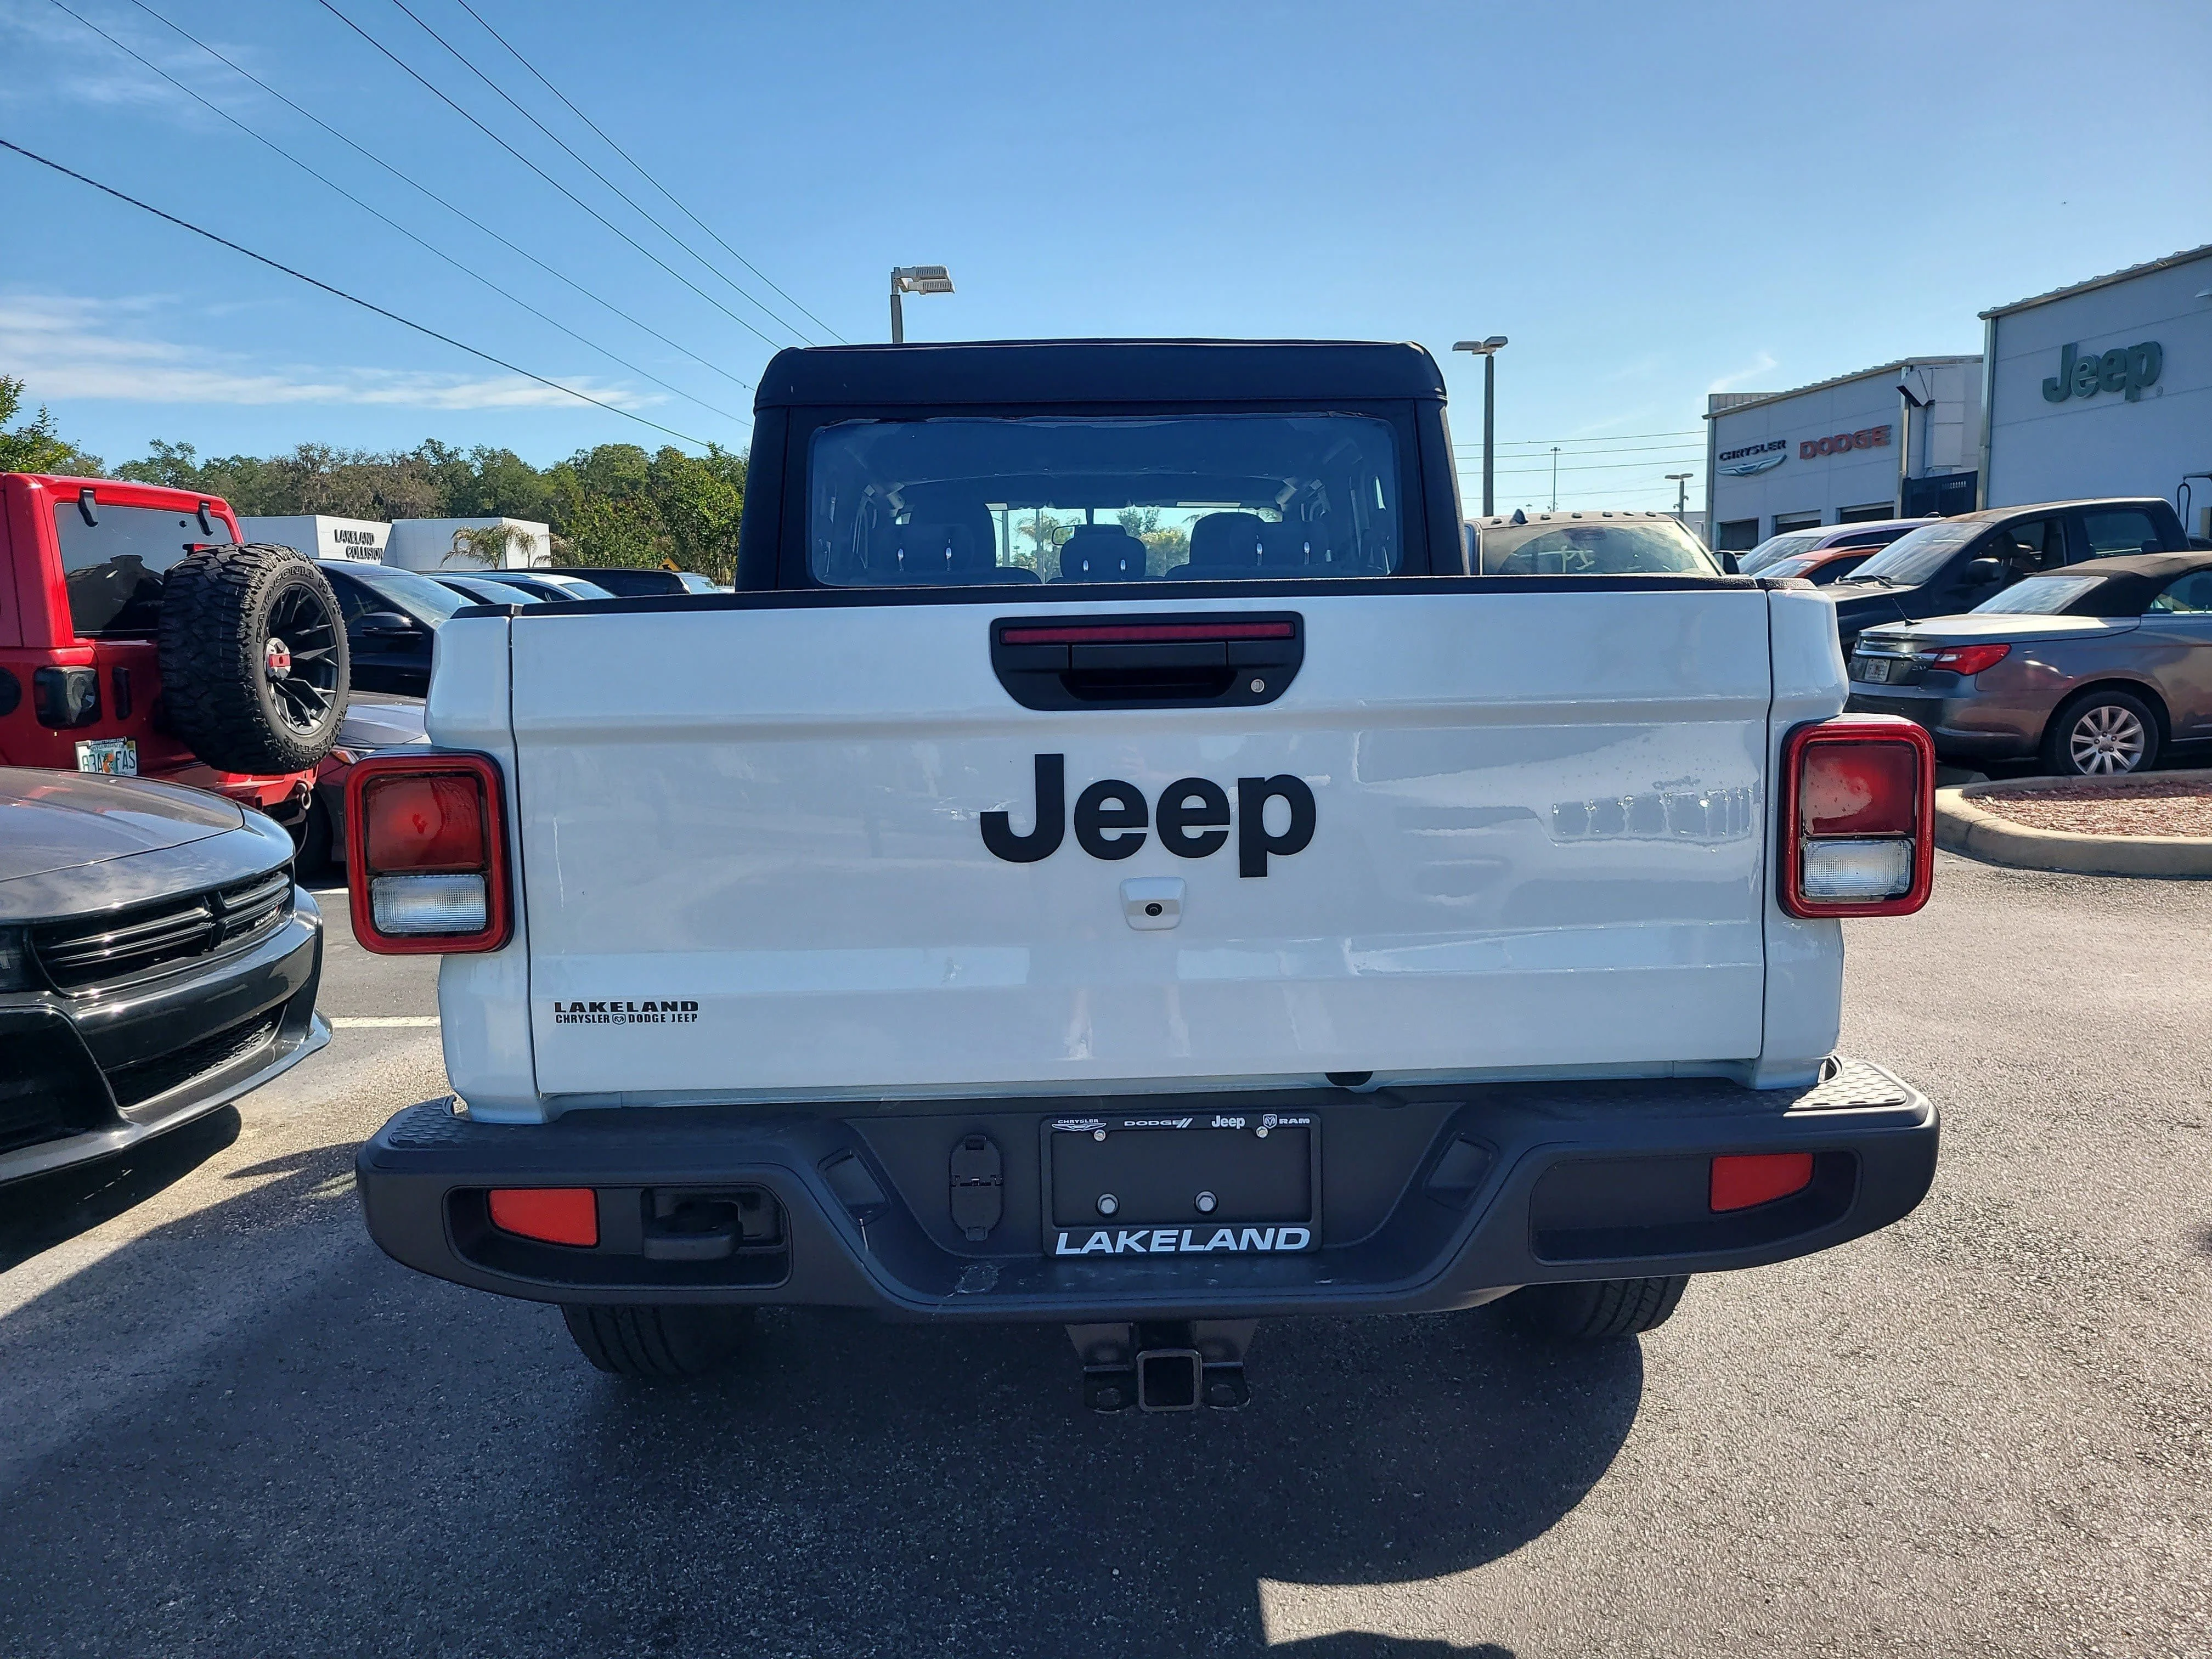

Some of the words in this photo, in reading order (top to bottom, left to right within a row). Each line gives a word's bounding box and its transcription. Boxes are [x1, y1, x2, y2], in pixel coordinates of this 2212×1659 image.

[2042, 341, 2163, 403] Jeep
[1718, 439, 1786, 461] CHRYSLER
[1799, 425, 1892, 460] DODGE
[334, 529, 375, 546] LAKELAND
[346, 545, 384, 560] COLLISION
[256, 565, 314, 644] PATAGONIA
[115, 749, 136, 770] FAS
[980, 753, 1317, 878] Jeep
[554, 1001, 698, 1013] LAKELAND
[556, 1014, 610, 1024] CHRYSLER
[629, 1014, 666, 1023] DODGE
[671, 1013, 698, 1023] JEEP
[1211, 1115, 1245, 1129] Jeep
[1055, 1228, 1311, 1255] LAKELAND
